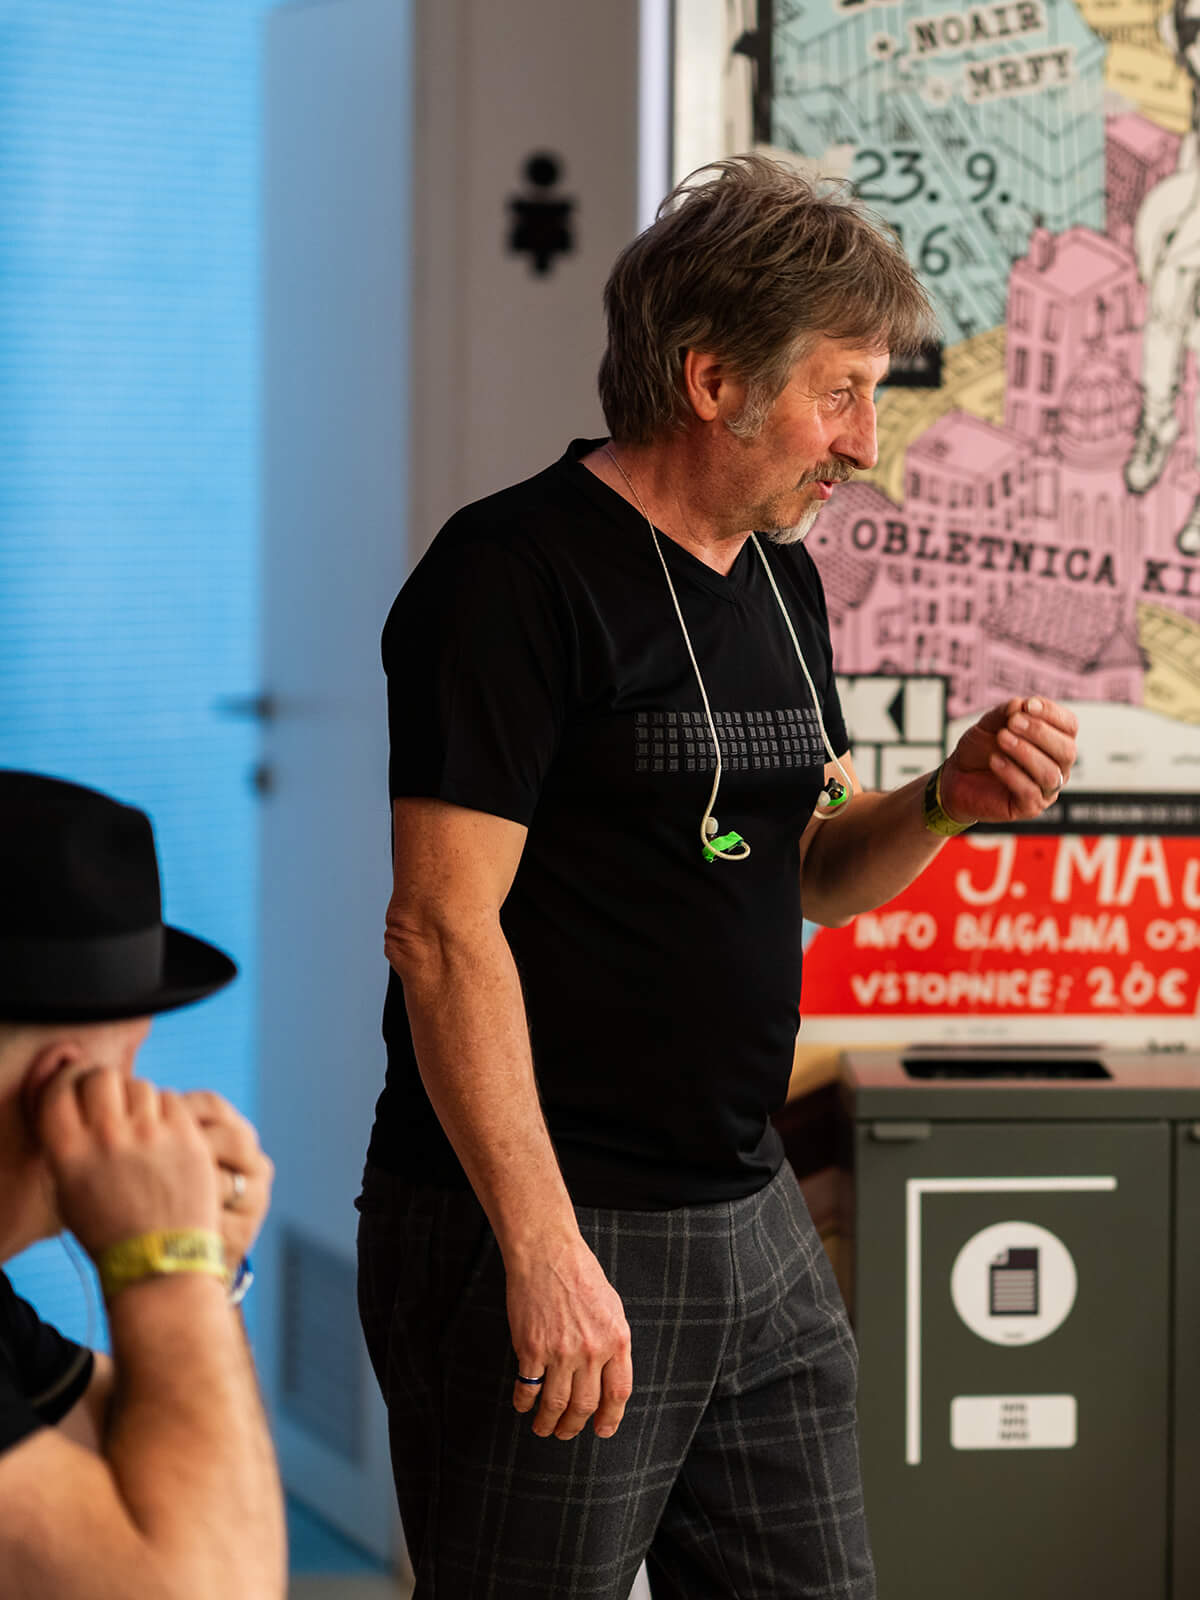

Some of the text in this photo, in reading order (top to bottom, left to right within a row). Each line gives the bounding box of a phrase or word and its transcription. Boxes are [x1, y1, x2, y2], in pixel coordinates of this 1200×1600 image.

[914, 2, 1044, 51] NOAIR
[968, 51, 1071, 98] MRFY
[852, 151, 1011, 204] 23. 9.
[852, 518, 1115, 586] OBLETNICA
[854, 911, 937, 950] INFO
[953, 912, 1130, 956] BLAGAJNA
